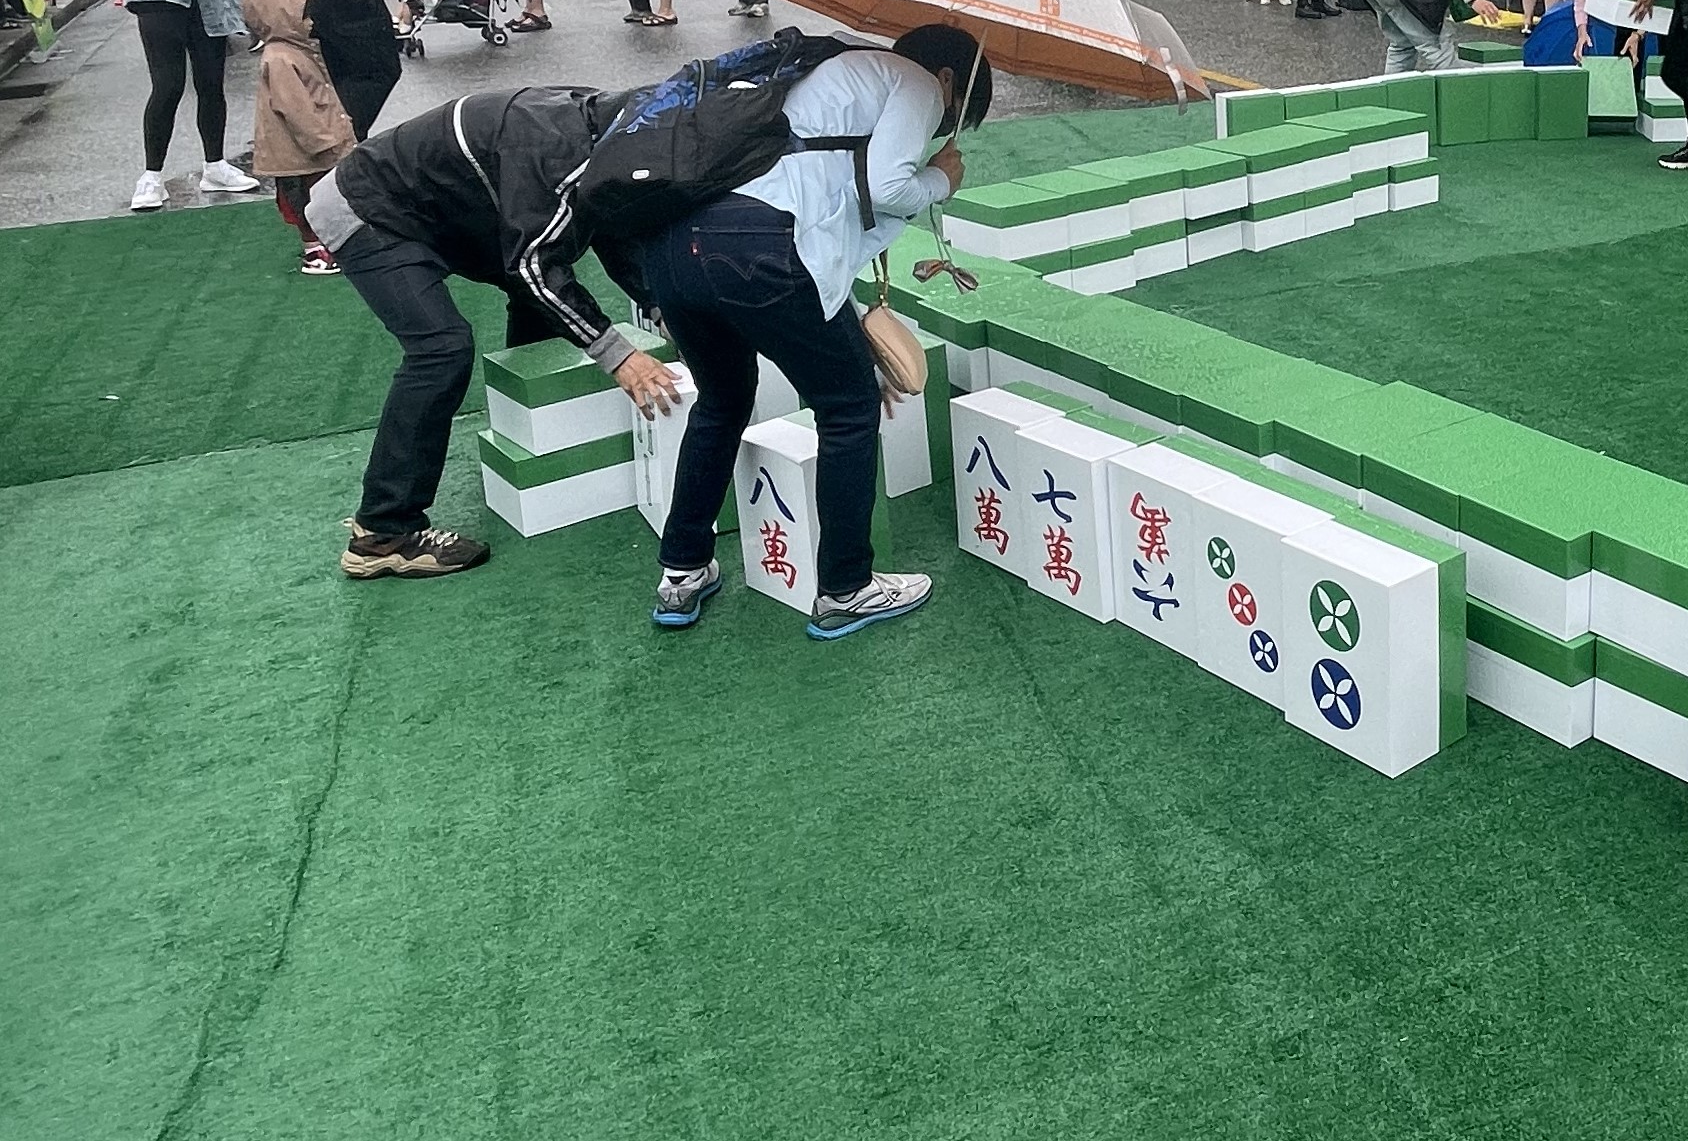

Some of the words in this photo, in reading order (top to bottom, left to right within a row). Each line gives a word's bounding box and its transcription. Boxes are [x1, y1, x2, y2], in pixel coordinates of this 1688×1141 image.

[749, 466, 797, 589] 八萬
[966, 434, 1011, 556] 八萬
[1031, 469, 1081, 596] 七萬
[1130, 491, 1181, 623] 六萬
